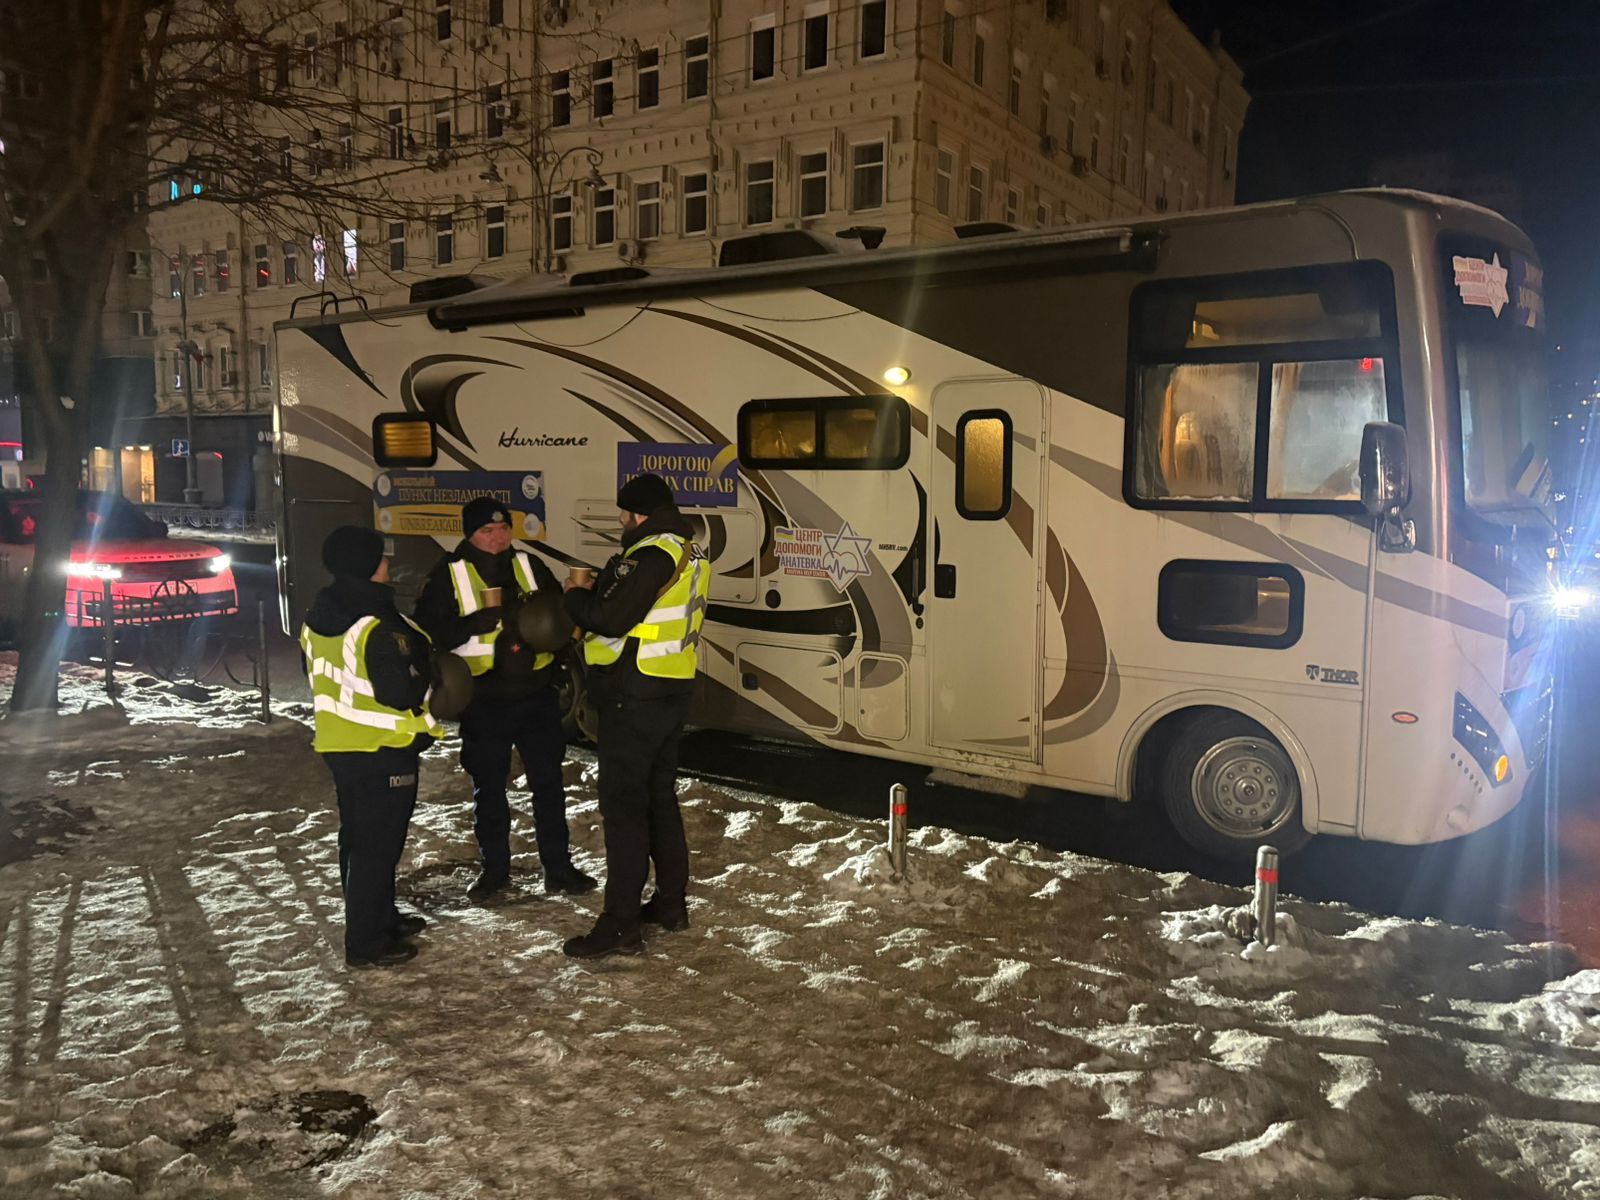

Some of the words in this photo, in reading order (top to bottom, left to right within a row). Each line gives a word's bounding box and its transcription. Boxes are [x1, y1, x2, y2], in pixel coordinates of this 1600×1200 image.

[498, 427, 588, 448] Hurricane
[637, 455, 711, 472] ДОРОГОЮ
[683, 476, 734, 493] СПРАВ
[399, 488, 432, 502] ПУНКТ
[795, 529, 823, 543] ЦЕНТР
[775, 541, 822, 557] ДОПОМОГИ
[780, 555, 823, 569] АНАТЕВКА
[1321, 667, 1359, 682] THOR
